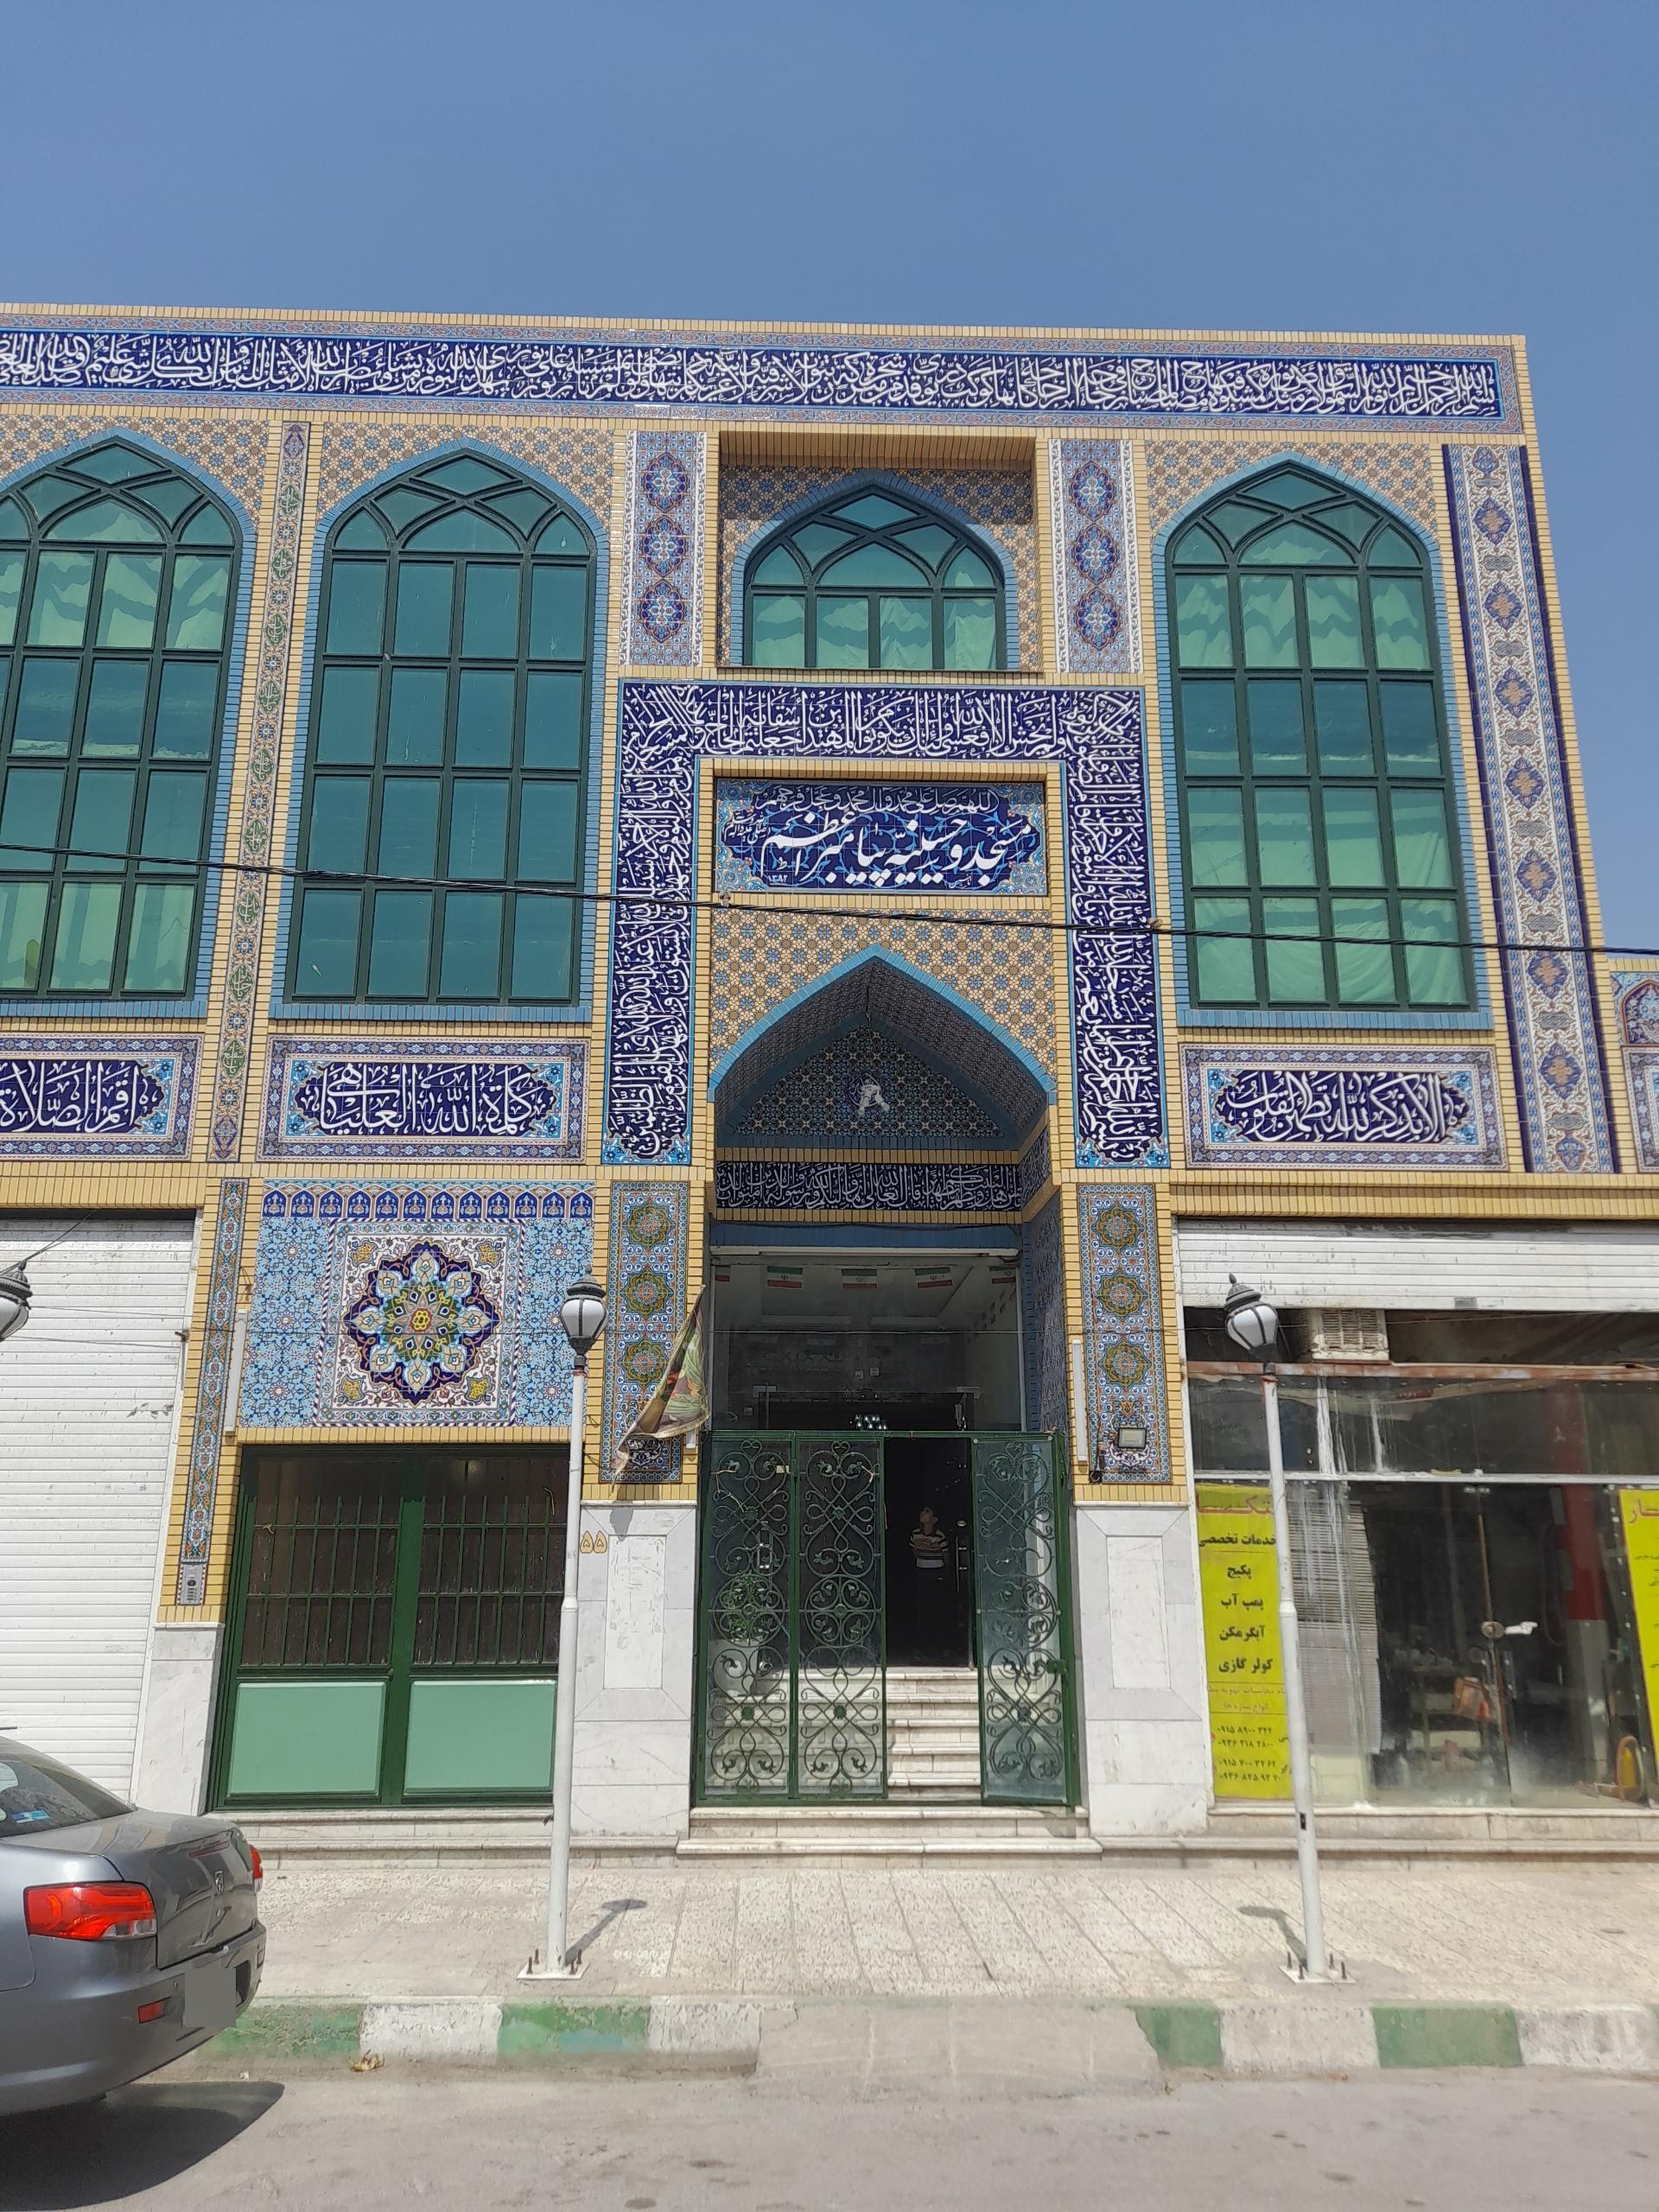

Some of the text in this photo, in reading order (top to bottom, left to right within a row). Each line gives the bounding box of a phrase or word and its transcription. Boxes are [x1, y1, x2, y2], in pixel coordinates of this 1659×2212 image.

[760, 810, 858, 880] اعظم
[797, 823, 893, 888] پیامبر
[957, 817, 1033, 886] مسجد
[941, 844, 967, 872] و
[580, 1529, 607, 1554] ۵۵
[1198, 1533, 1276, 1548] خدمات تخصصی
[1227, 1565, 1251, 1580] پکیج
[1221, 1593, 1263, 1611] پمپ آب
[1219, 1658, 1274, 1674] کولر گازی
